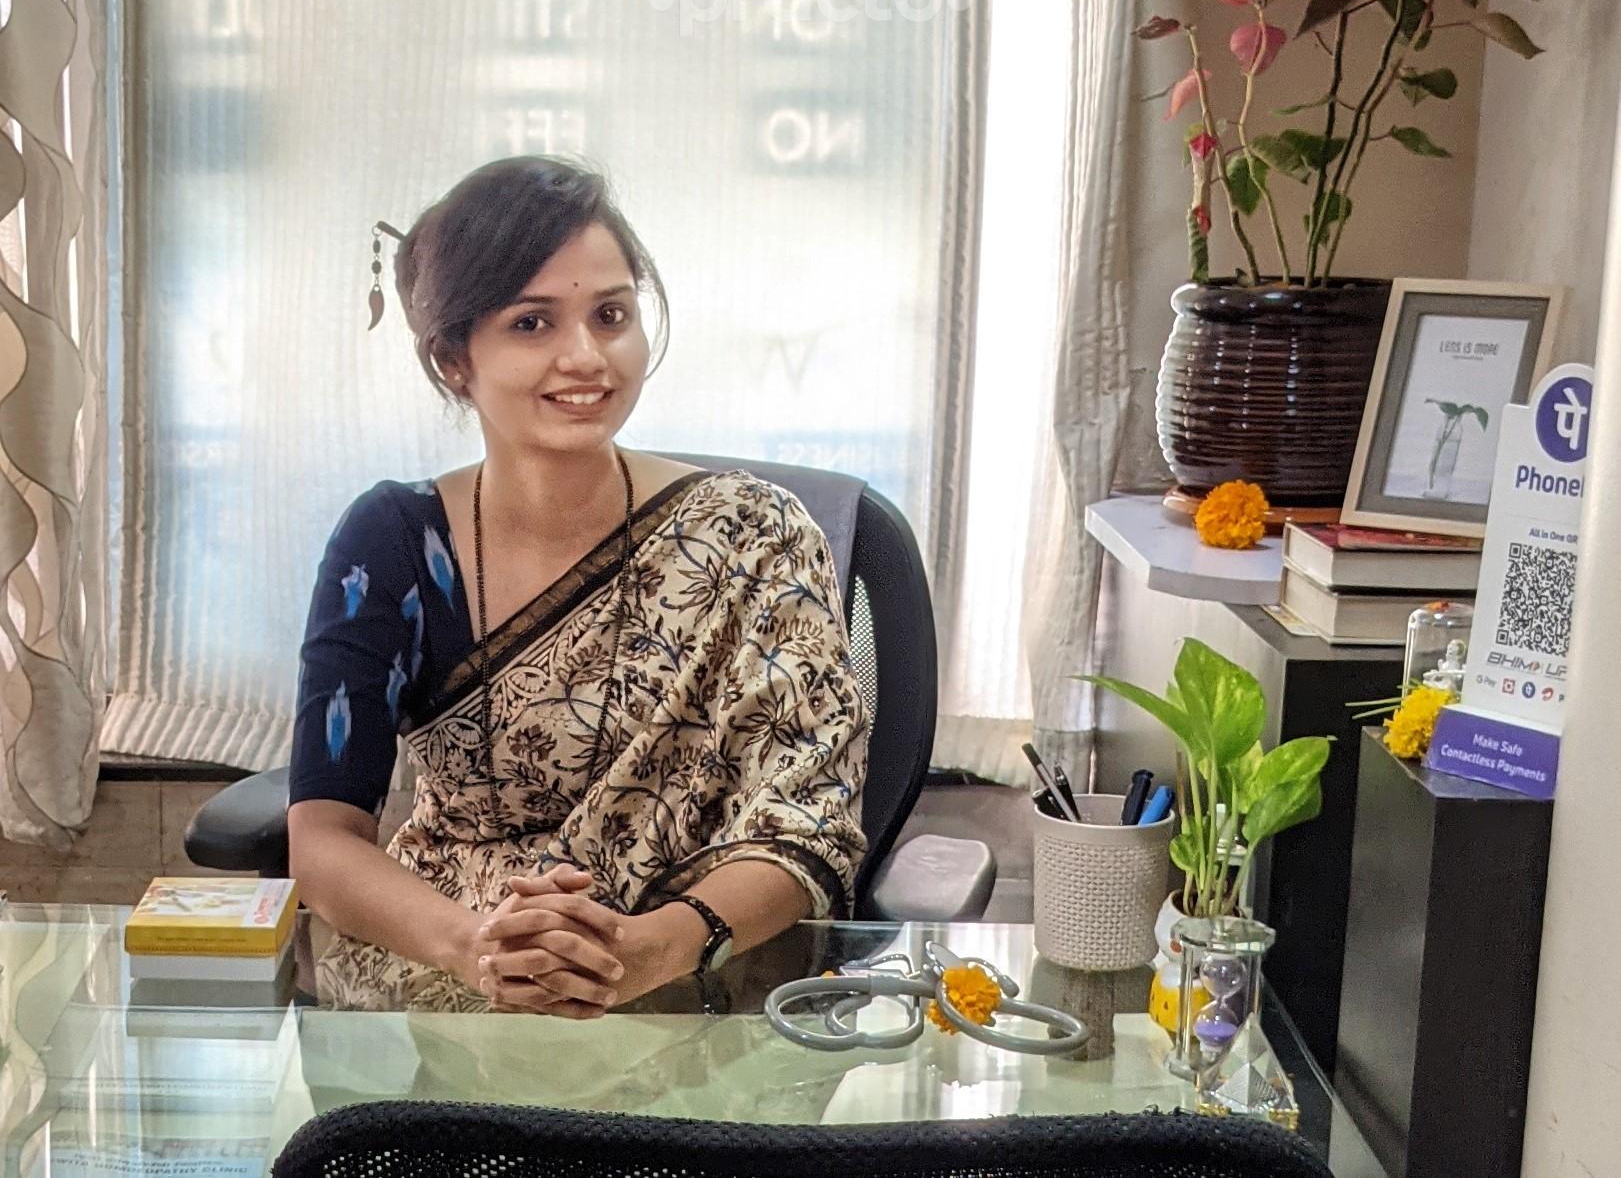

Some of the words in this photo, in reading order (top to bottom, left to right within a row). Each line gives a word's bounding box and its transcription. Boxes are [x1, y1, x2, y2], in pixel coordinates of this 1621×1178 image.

[1487, 651, 1532, 670] BHIM
[1472, 733, 1499, 751] Make
[1500, 740, 1523, 757] Safe
[1440, 743, 1496, 769] Contactless
[1496, 759, 1547, 782] Payments
